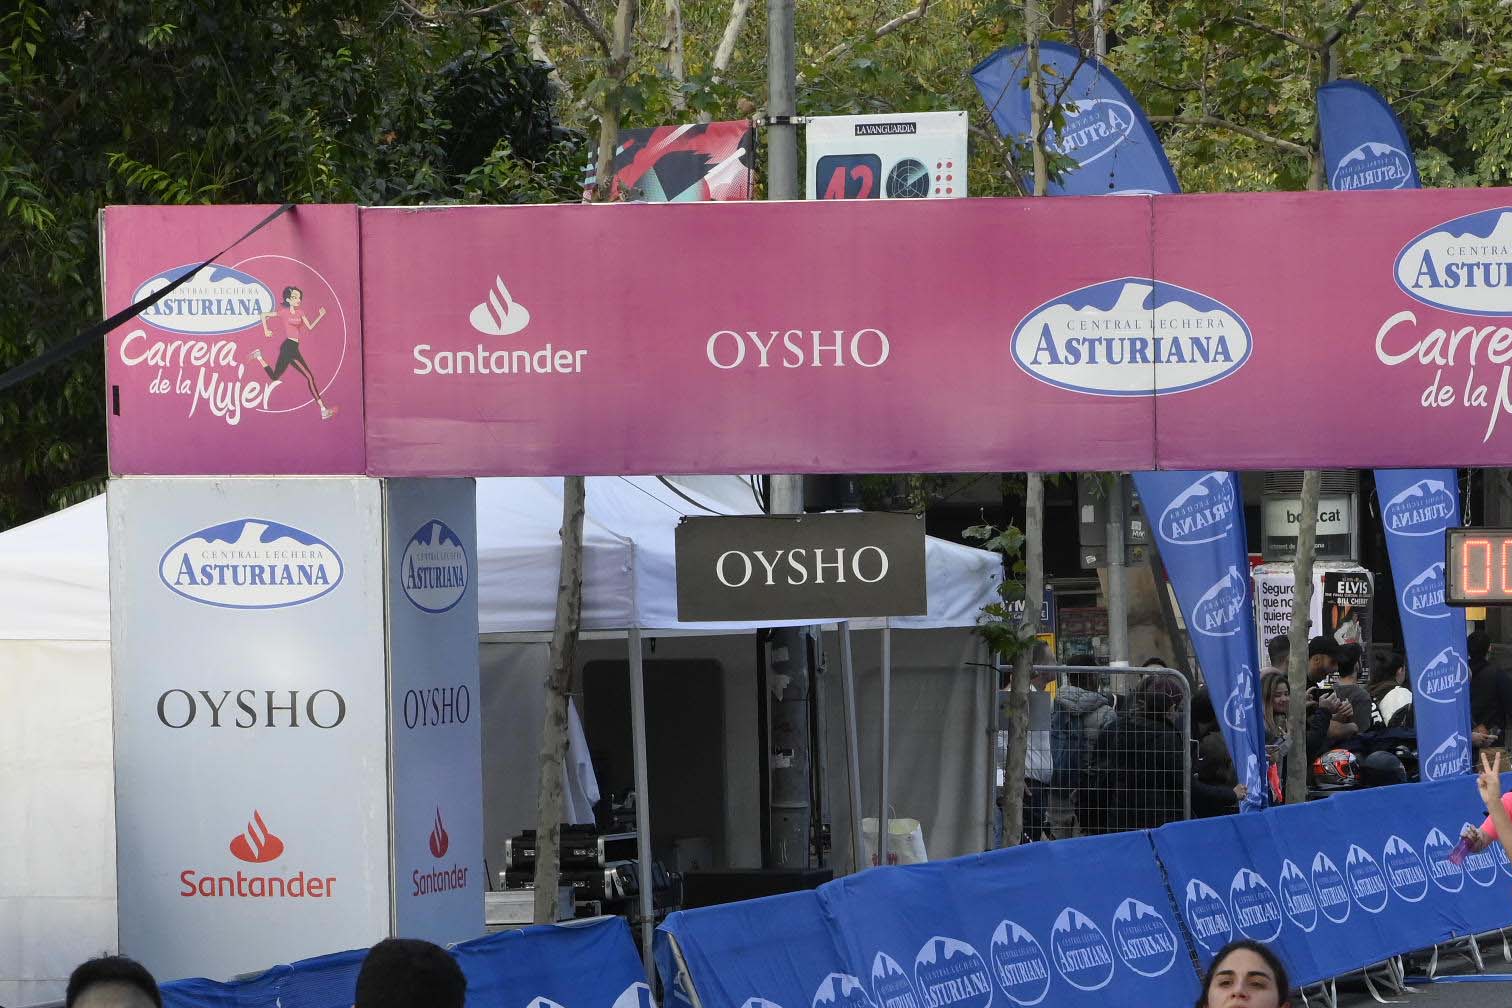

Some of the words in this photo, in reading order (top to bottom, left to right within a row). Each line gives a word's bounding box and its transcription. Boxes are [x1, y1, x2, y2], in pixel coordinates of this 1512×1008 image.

[1067, 319, 1143, 331] CENTRAL
[1150, 317, 1226, 329] LECHERA
[120, 329, 238, 367] Carrera
[412, 343, 588, 375] Santander
[706, 328, 890, 369] OYSHO
[1030, 322, 1234, 366] ASTURIANA
[150, 368, 171, 394] de
[176, 368, 191, 394] la
[188, 363, 283, 425] Mujer
[1421, 368, 1455, 408] de
[1463, 367, 1488, 407] la
[174, 552, 330, 586] ASTURIANA
[201, 550, 261, 560] CENTRAL
[265, 549, 324, 559] LECHERA
[715, 545, 889, 588] OYSHO
[407, 555, 464, 590] ASTURIANA
[1337, 582, 1368, 594] ELVIS
[1263, 598, 1279, 609] que
[156, 688, 346, 729] OYSHO
[403, 684, 470, 729] OYSHO
[180, 870, 336, 897] Santander
[412, 863, 468, 896] Santander
[995, 955, 1048, 987] ASTURIANA
[1057, 941, 1111, 973] ASTURIANA
[919, 971, 990, 1008] ASTURIANA
